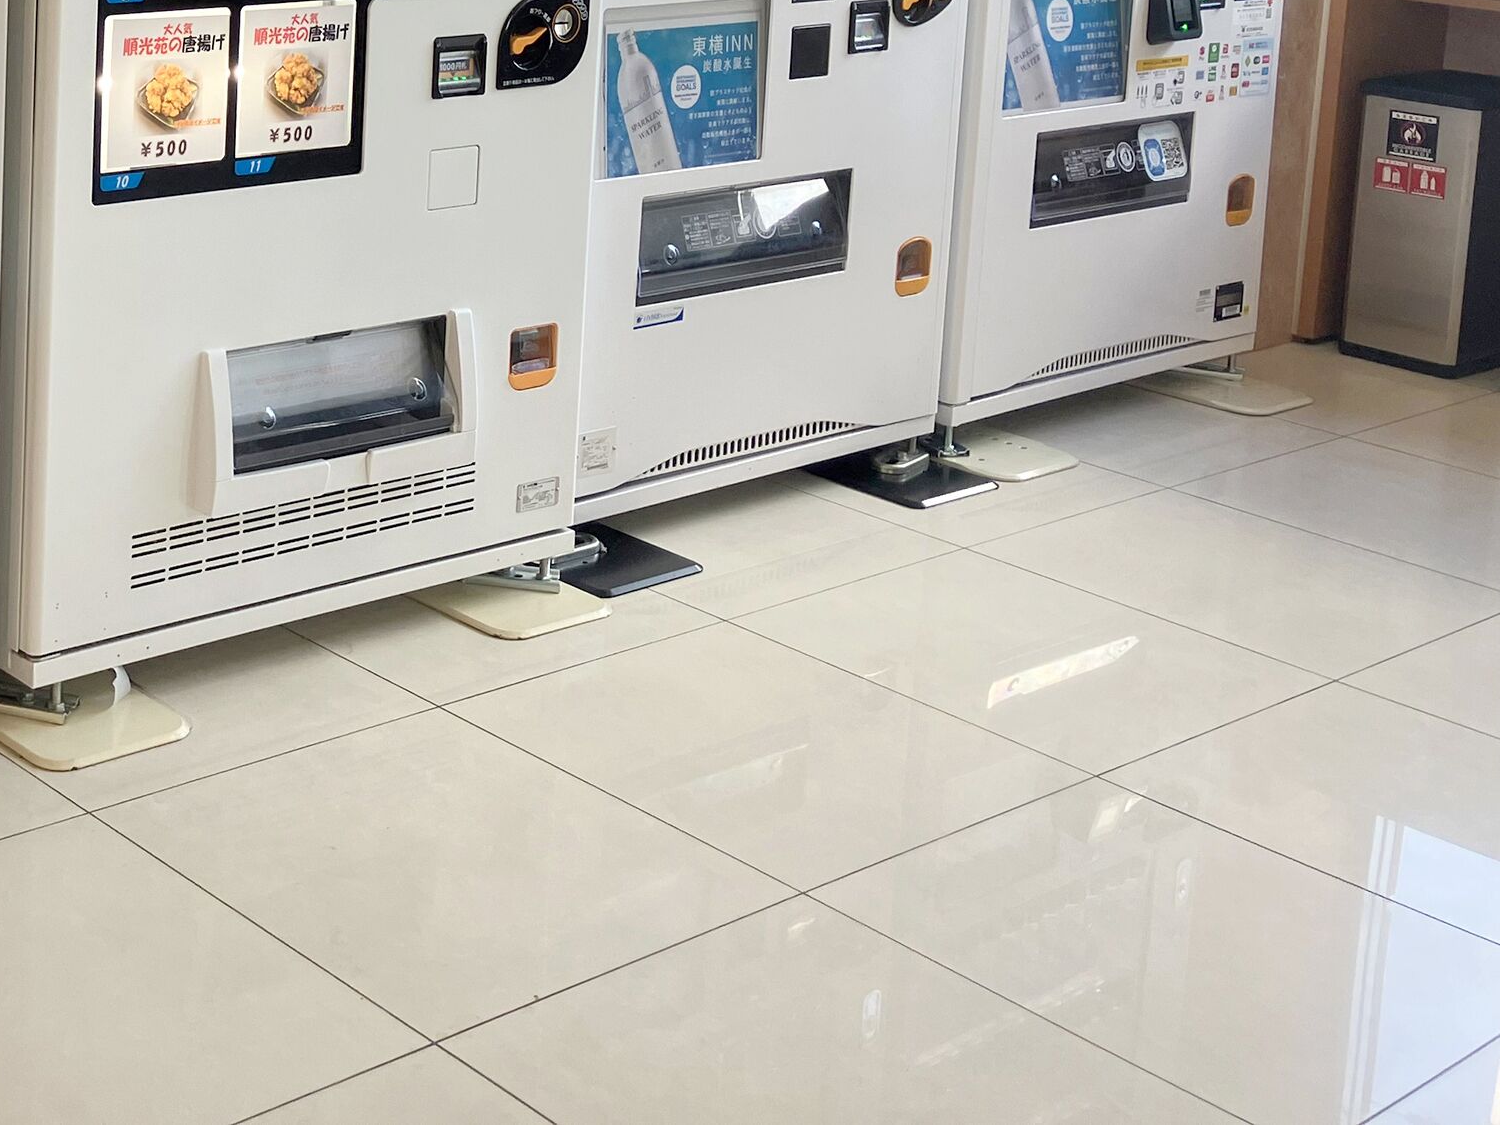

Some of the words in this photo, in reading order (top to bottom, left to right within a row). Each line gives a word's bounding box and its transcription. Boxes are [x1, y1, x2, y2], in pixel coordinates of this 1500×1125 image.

[291, 12, 320, 25] 大人気
[163, 22, 193, 36] 大人気
[253, 23, 350, 46] 順光苑の唐揚げ
[122, 33, 226, 57] 順光苑の唐揚げ
[692, 33, 755, 57] 東横INN
[702, 56, 753, 73] 炭酸水誕生
[1020, 53, 1041, 73] WATER
[675, 83, 697, 92] GOALS
[269, 125, 313, 143] ¥500
[637, 120, 662, 139] WATER
[140, 139, 188, 157] ¥500
[249, 160, 262, 173] 11
[115, 175, 130, 189] 10
